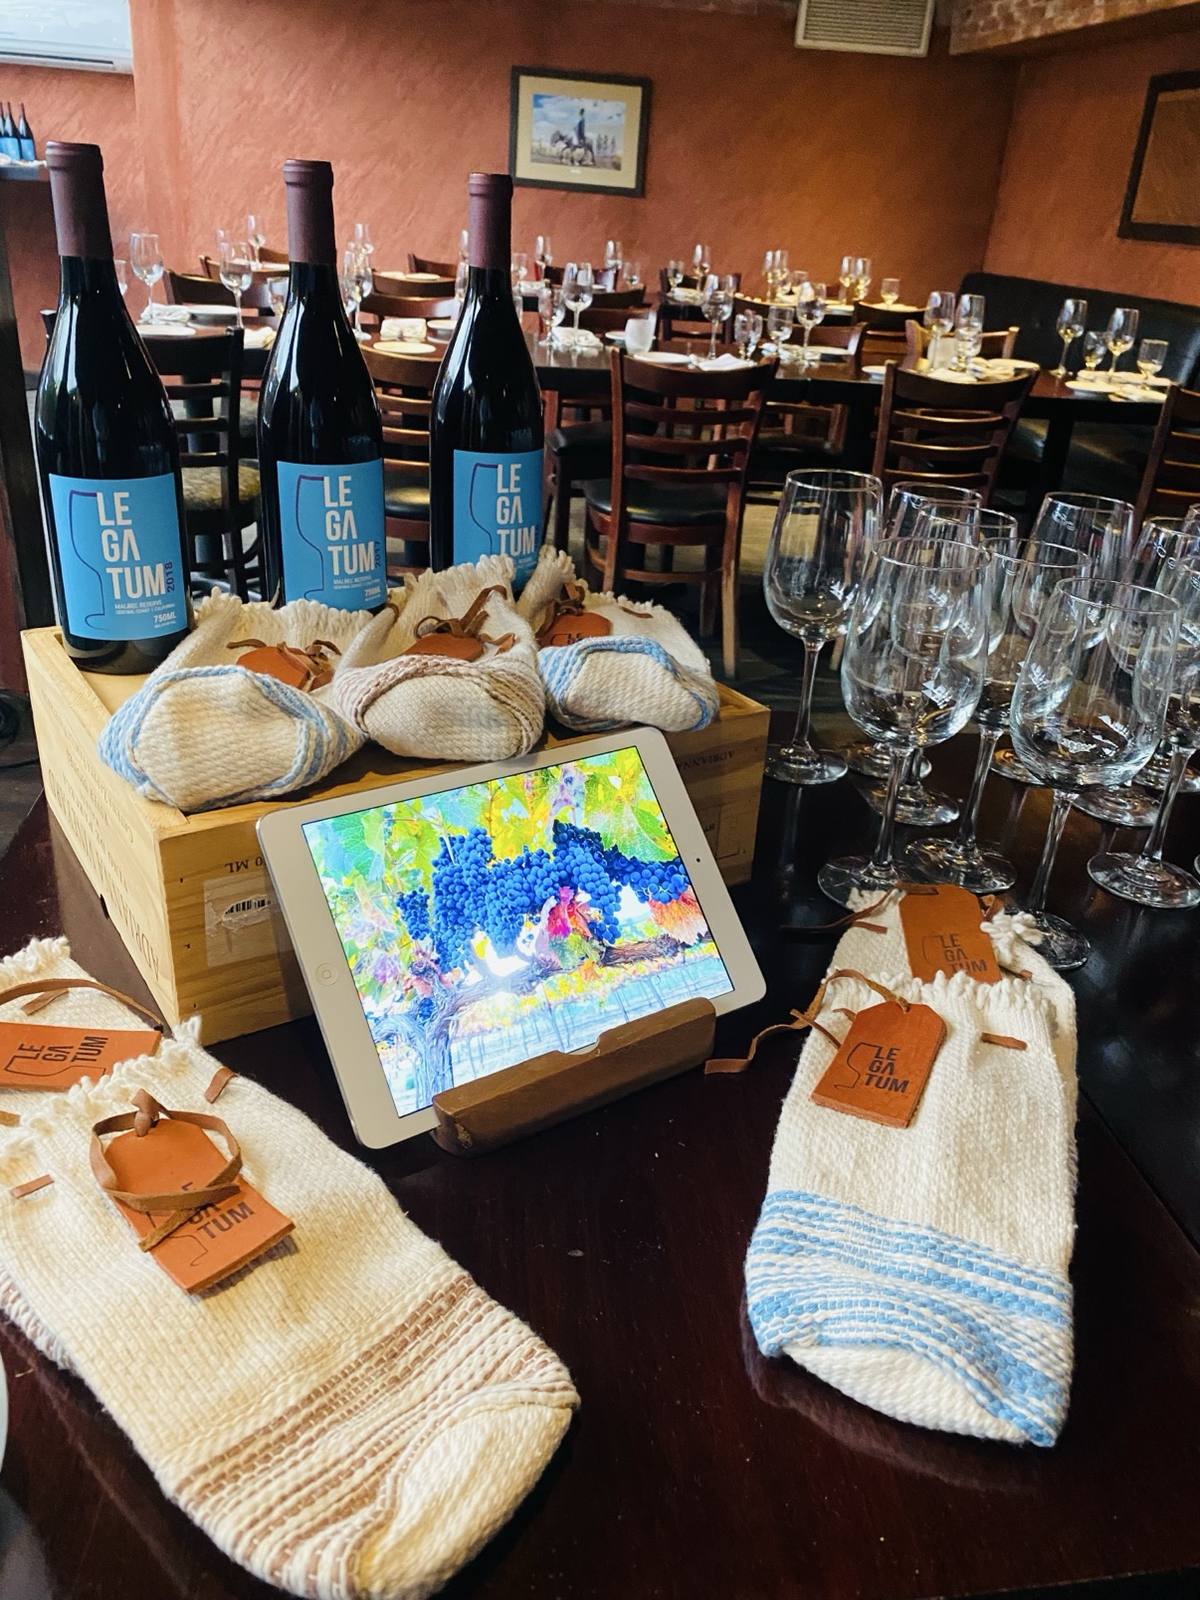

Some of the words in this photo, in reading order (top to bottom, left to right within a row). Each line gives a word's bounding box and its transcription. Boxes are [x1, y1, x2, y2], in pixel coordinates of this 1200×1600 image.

[323, 475, 353, 507] LE
[496, 463, 522, 493] LE
[96, 491, 132, 526] LE
[496, 495, 523, 525] GA
[325, 510, 358, 541] GA
[101, 528, 141, 562] GA
[496, 526, 536, 556] TUM
[327, 541, 375, 576] TUM
[106, 563, 167, 600] TUM
[165, 561, 175, 593] 2018
[224, 859, 249, 873] ML
[940, 933, 961, 948] LE
[944, 948, 967, 962] GA
[18, 1043, 44, 1060] LE
[42, 1045, 74, 1062] GA
[71, 1036, 109, 1062] TUM
[873, 1046, 900, 1061] LE
[868, 1059, 896, 1075] GA
[864, 1073, 909, 1094] TUM
[197, 1202, 254, 1239] TUM
